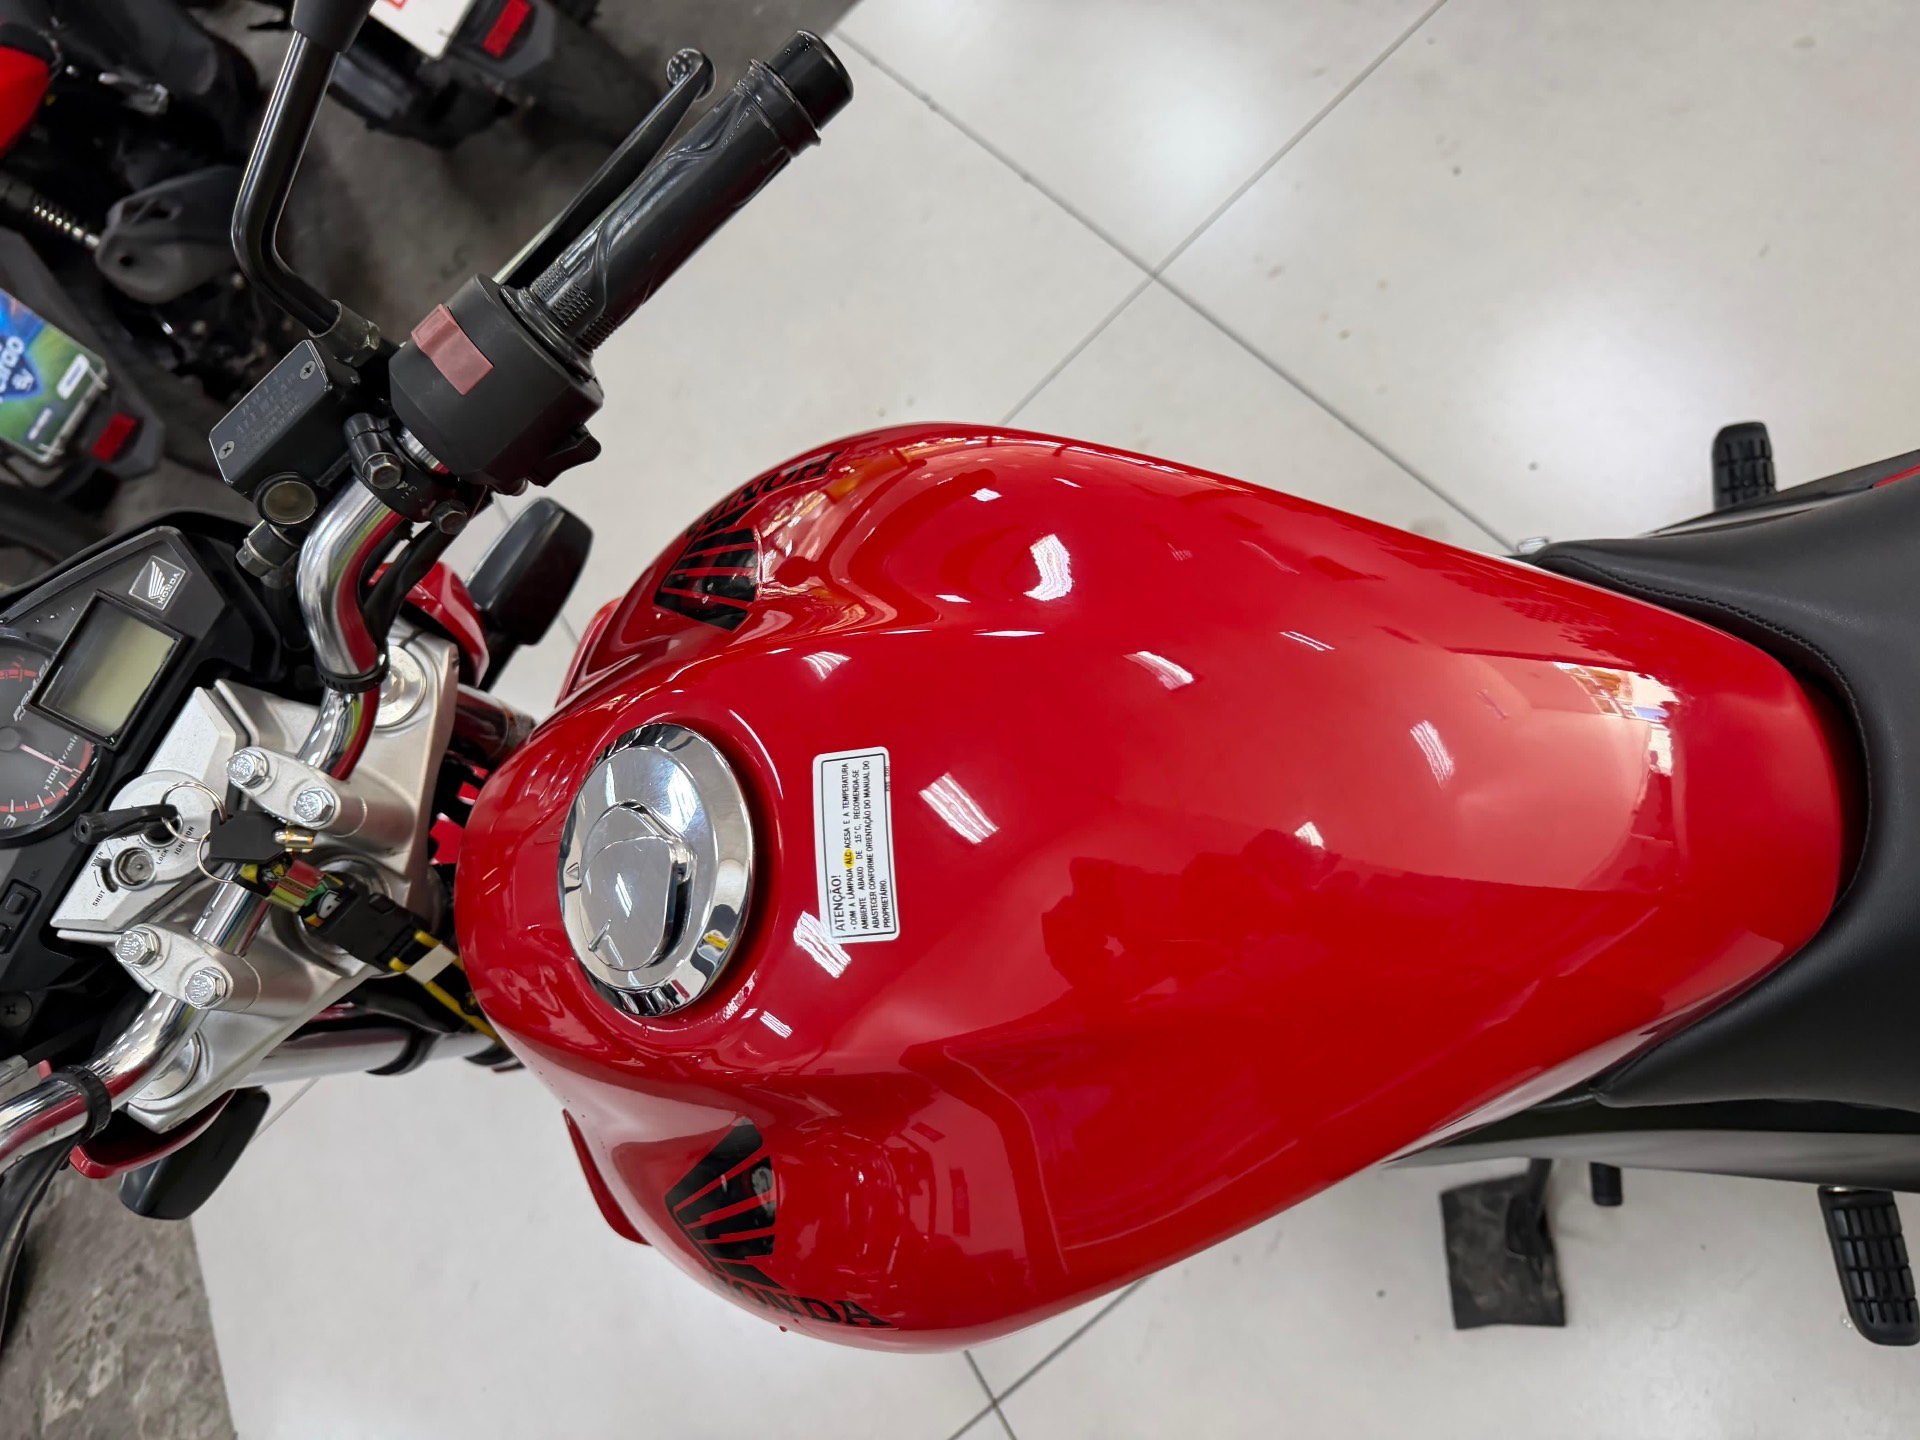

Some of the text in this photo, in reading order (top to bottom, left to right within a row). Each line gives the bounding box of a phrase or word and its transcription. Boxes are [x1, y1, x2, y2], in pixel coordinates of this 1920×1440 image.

[158, 573, 180, 604] HONDA
[841, 763, 850, 809] TEMPERATURA
[852, 769, 861, 819] RECOMENDA-SE
[174, 826, 195, 855] IGNION
[843, 828, 851, 848] ACESA
[862, 761, 879, 929] ABASTECER CONFORME ORIENTAÇÃO DO MANUAL DO
[156, 848, 169, 865] LOCK
[855, 850, 863, 859] DE
[846, 868, 855, 899] LÂMPADA
[857, 866, 865, 890] ABAIXO
[92, 890, 105, 907] SHUT
[830, 875, 846, 931] ATENÇÃO!
[859, 897, 869, 930] AMBIENTE
[879, 879, 891, 928] PROPRIETÁRIO.
